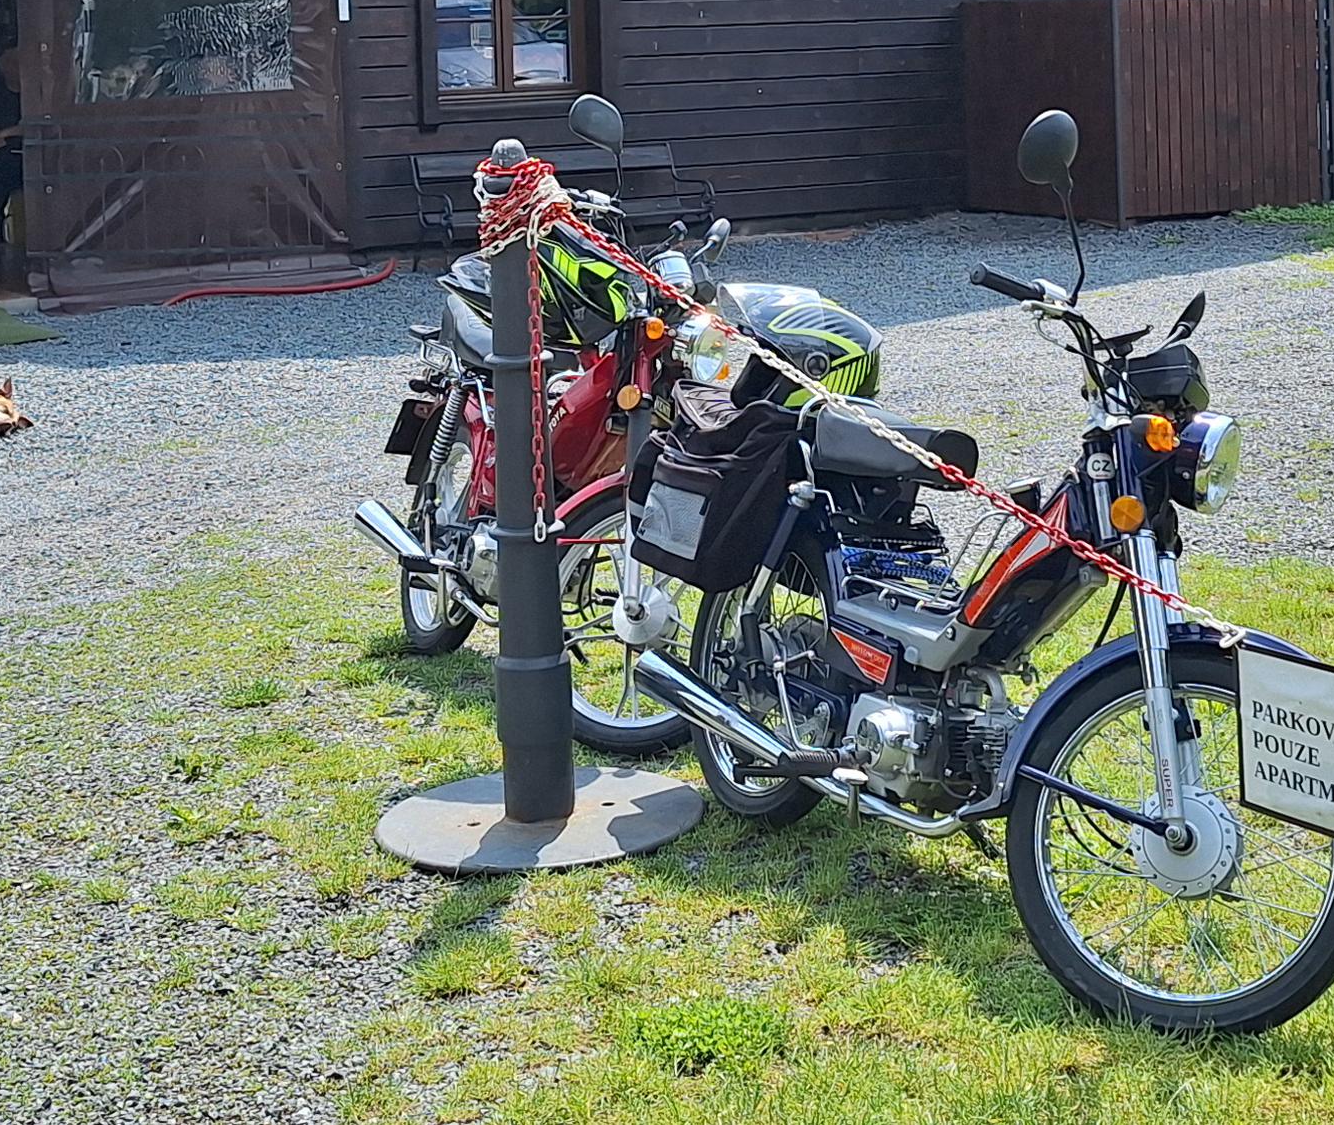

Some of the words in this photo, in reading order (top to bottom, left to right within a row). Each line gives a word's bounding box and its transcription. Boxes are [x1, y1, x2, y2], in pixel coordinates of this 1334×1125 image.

[1091, 459, 1112, 473] CZ
[1252, 730, 1321, 767] POUZE
[1161, 758, 1174, 809] SUPER
